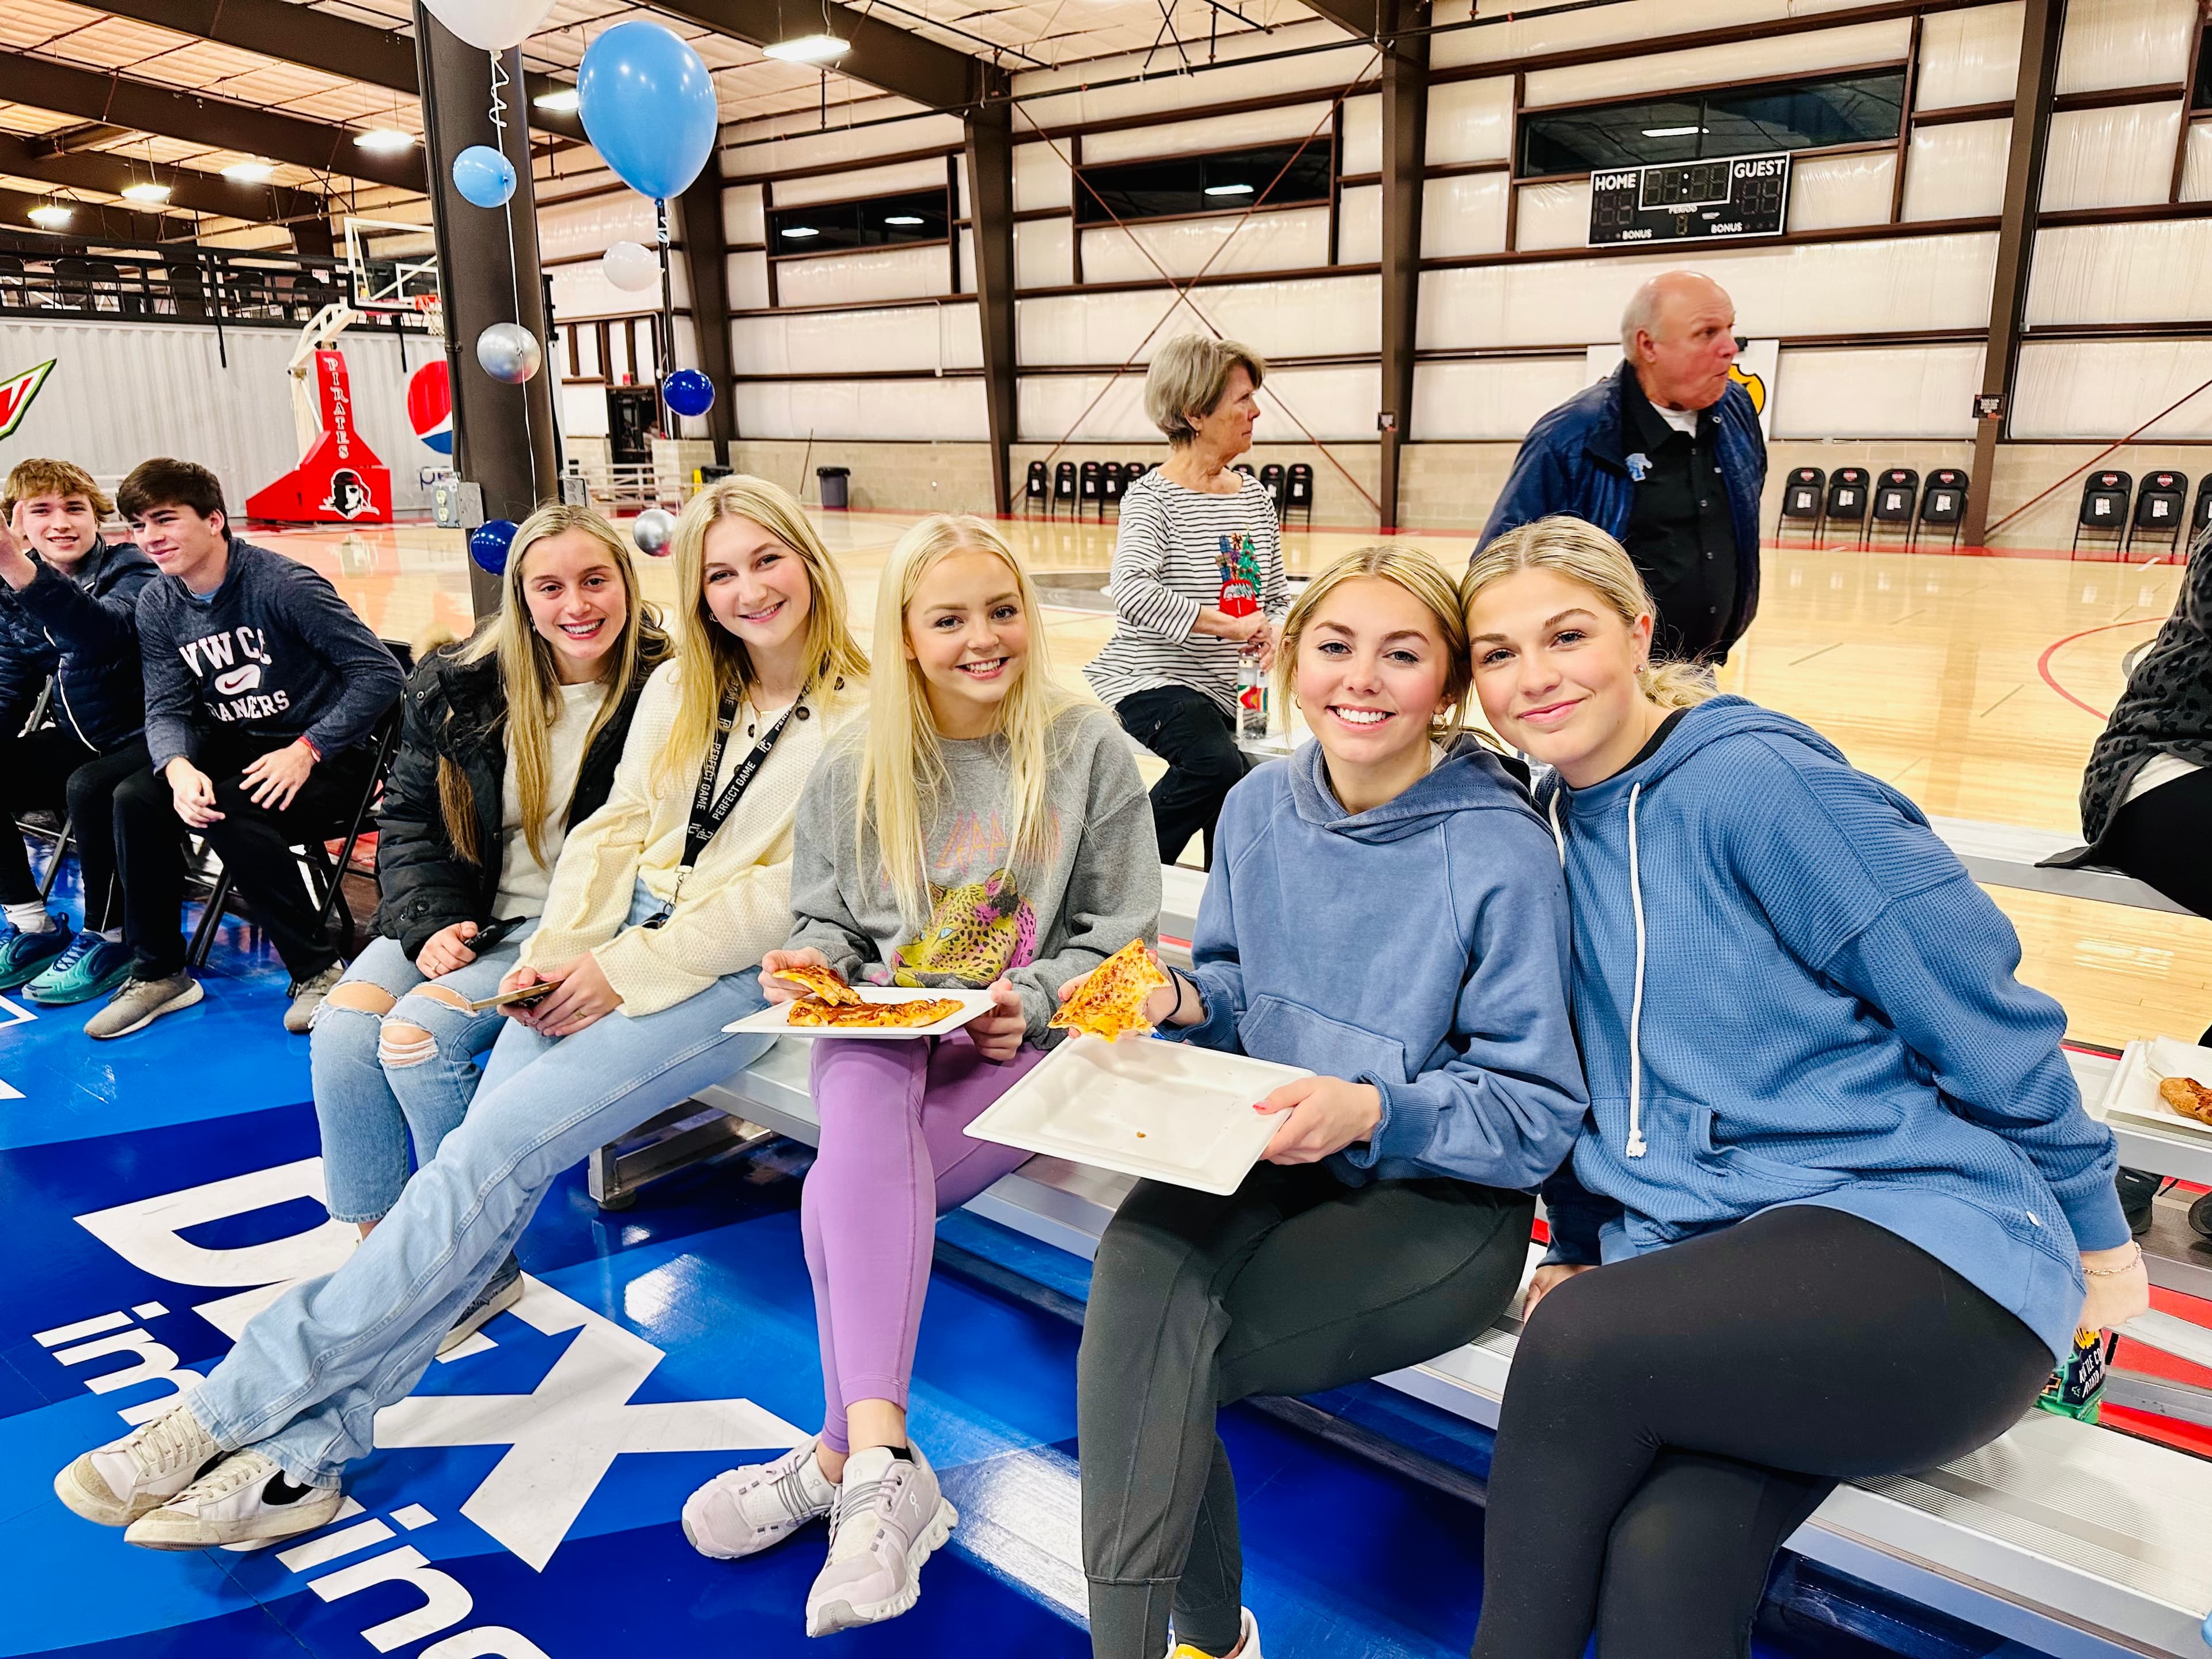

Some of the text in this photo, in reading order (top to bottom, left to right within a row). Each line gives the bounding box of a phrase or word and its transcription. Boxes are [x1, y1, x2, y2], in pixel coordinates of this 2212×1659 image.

[1734, 159, 1785, 179] GUEST
[1594, 173, 1637, 191] HOME
[1669, 206, 1698, 215] PERIOD
[1622, 229, 1653, 240] BONUS
[1711, 222, 1743, 234] BONUS
[323, 357, 349, 460] PIRATES
[696, 783, 711, 811] GAME
[712, 760, 756, 821] PERFECT GAME
